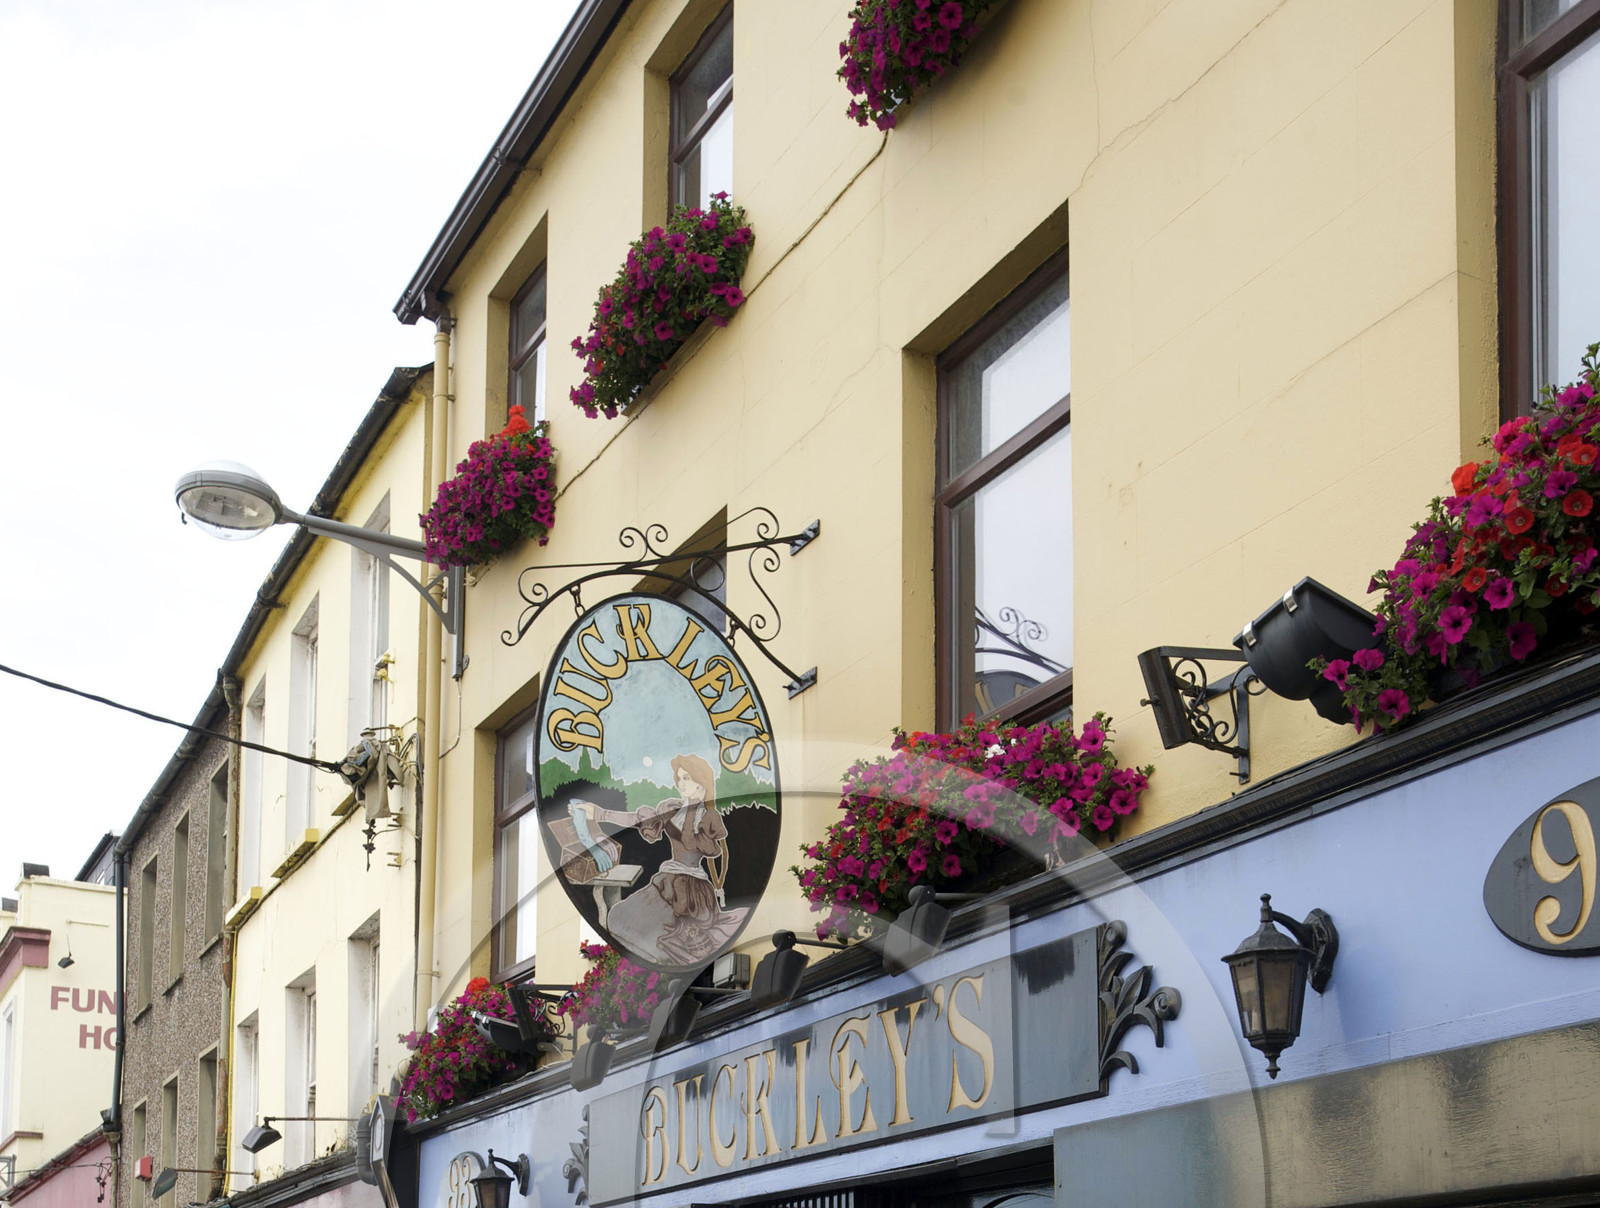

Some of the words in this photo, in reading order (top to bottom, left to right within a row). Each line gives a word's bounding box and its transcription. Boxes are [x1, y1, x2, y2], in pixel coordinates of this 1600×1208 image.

[547, 603, 772, 774] BUCKLEY'S
[1530, 800, 1597, 945] 9
[640, 972, 995, 1187] BUCKLEY'S
